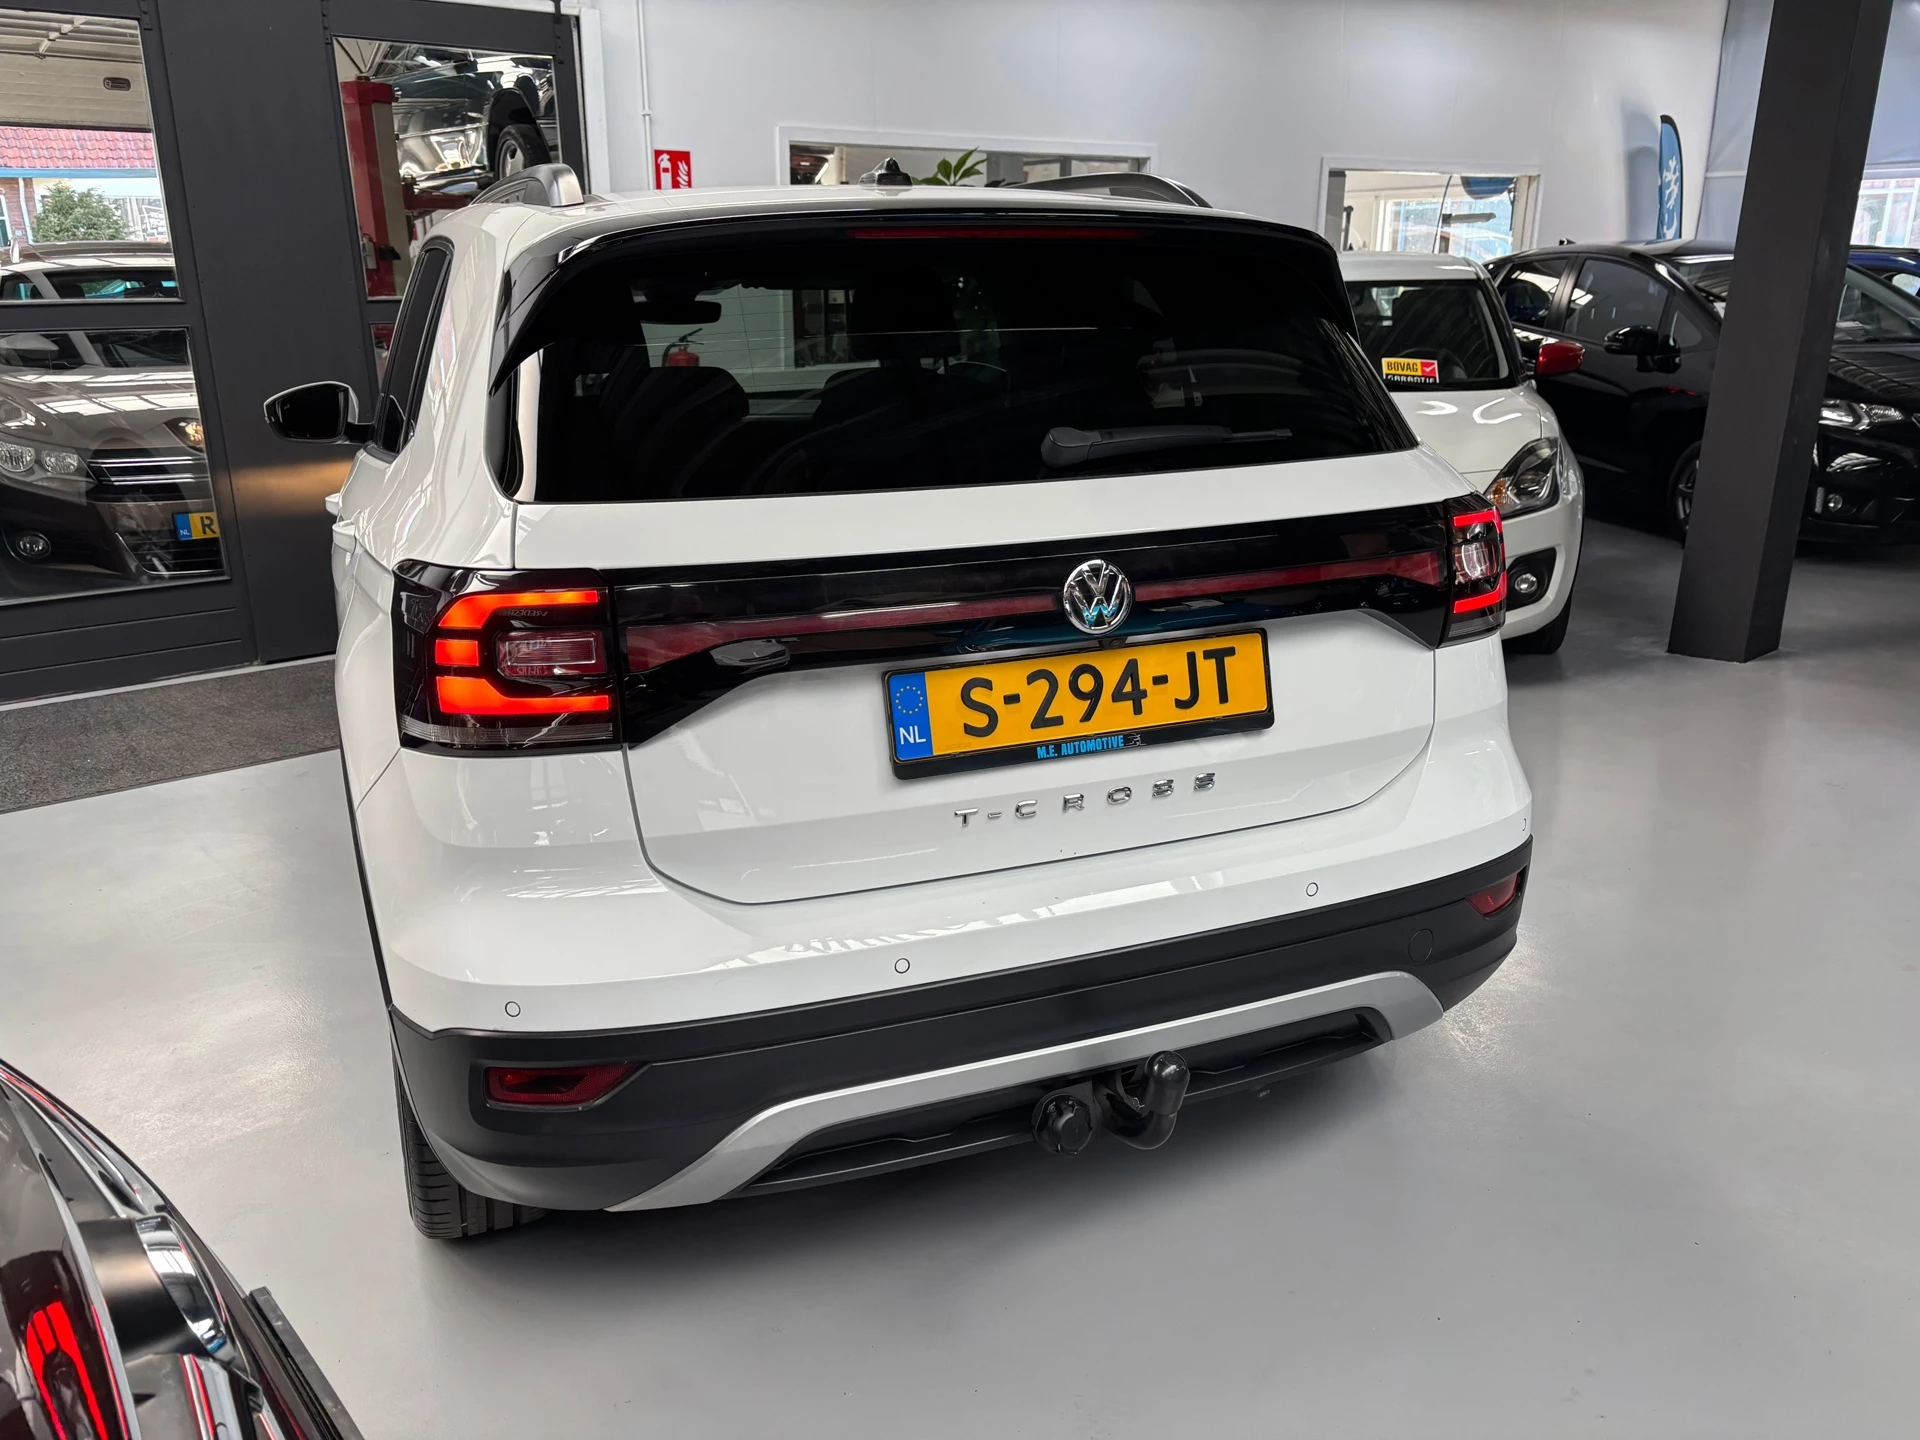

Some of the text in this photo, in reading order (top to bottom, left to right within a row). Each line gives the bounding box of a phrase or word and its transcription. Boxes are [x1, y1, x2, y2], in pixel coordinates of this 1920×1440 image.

[1387, 361, 1418, 373] BOVAG
[200, 515, 217, 535] R
[960, 646, 1236, 737] S-294-JT
[899, 726, 926, 744] NL
[1036, 735, 1125, 759] M.E. AUTOMOTIVE
[954, 772, 1216, 827] T-CROSS
